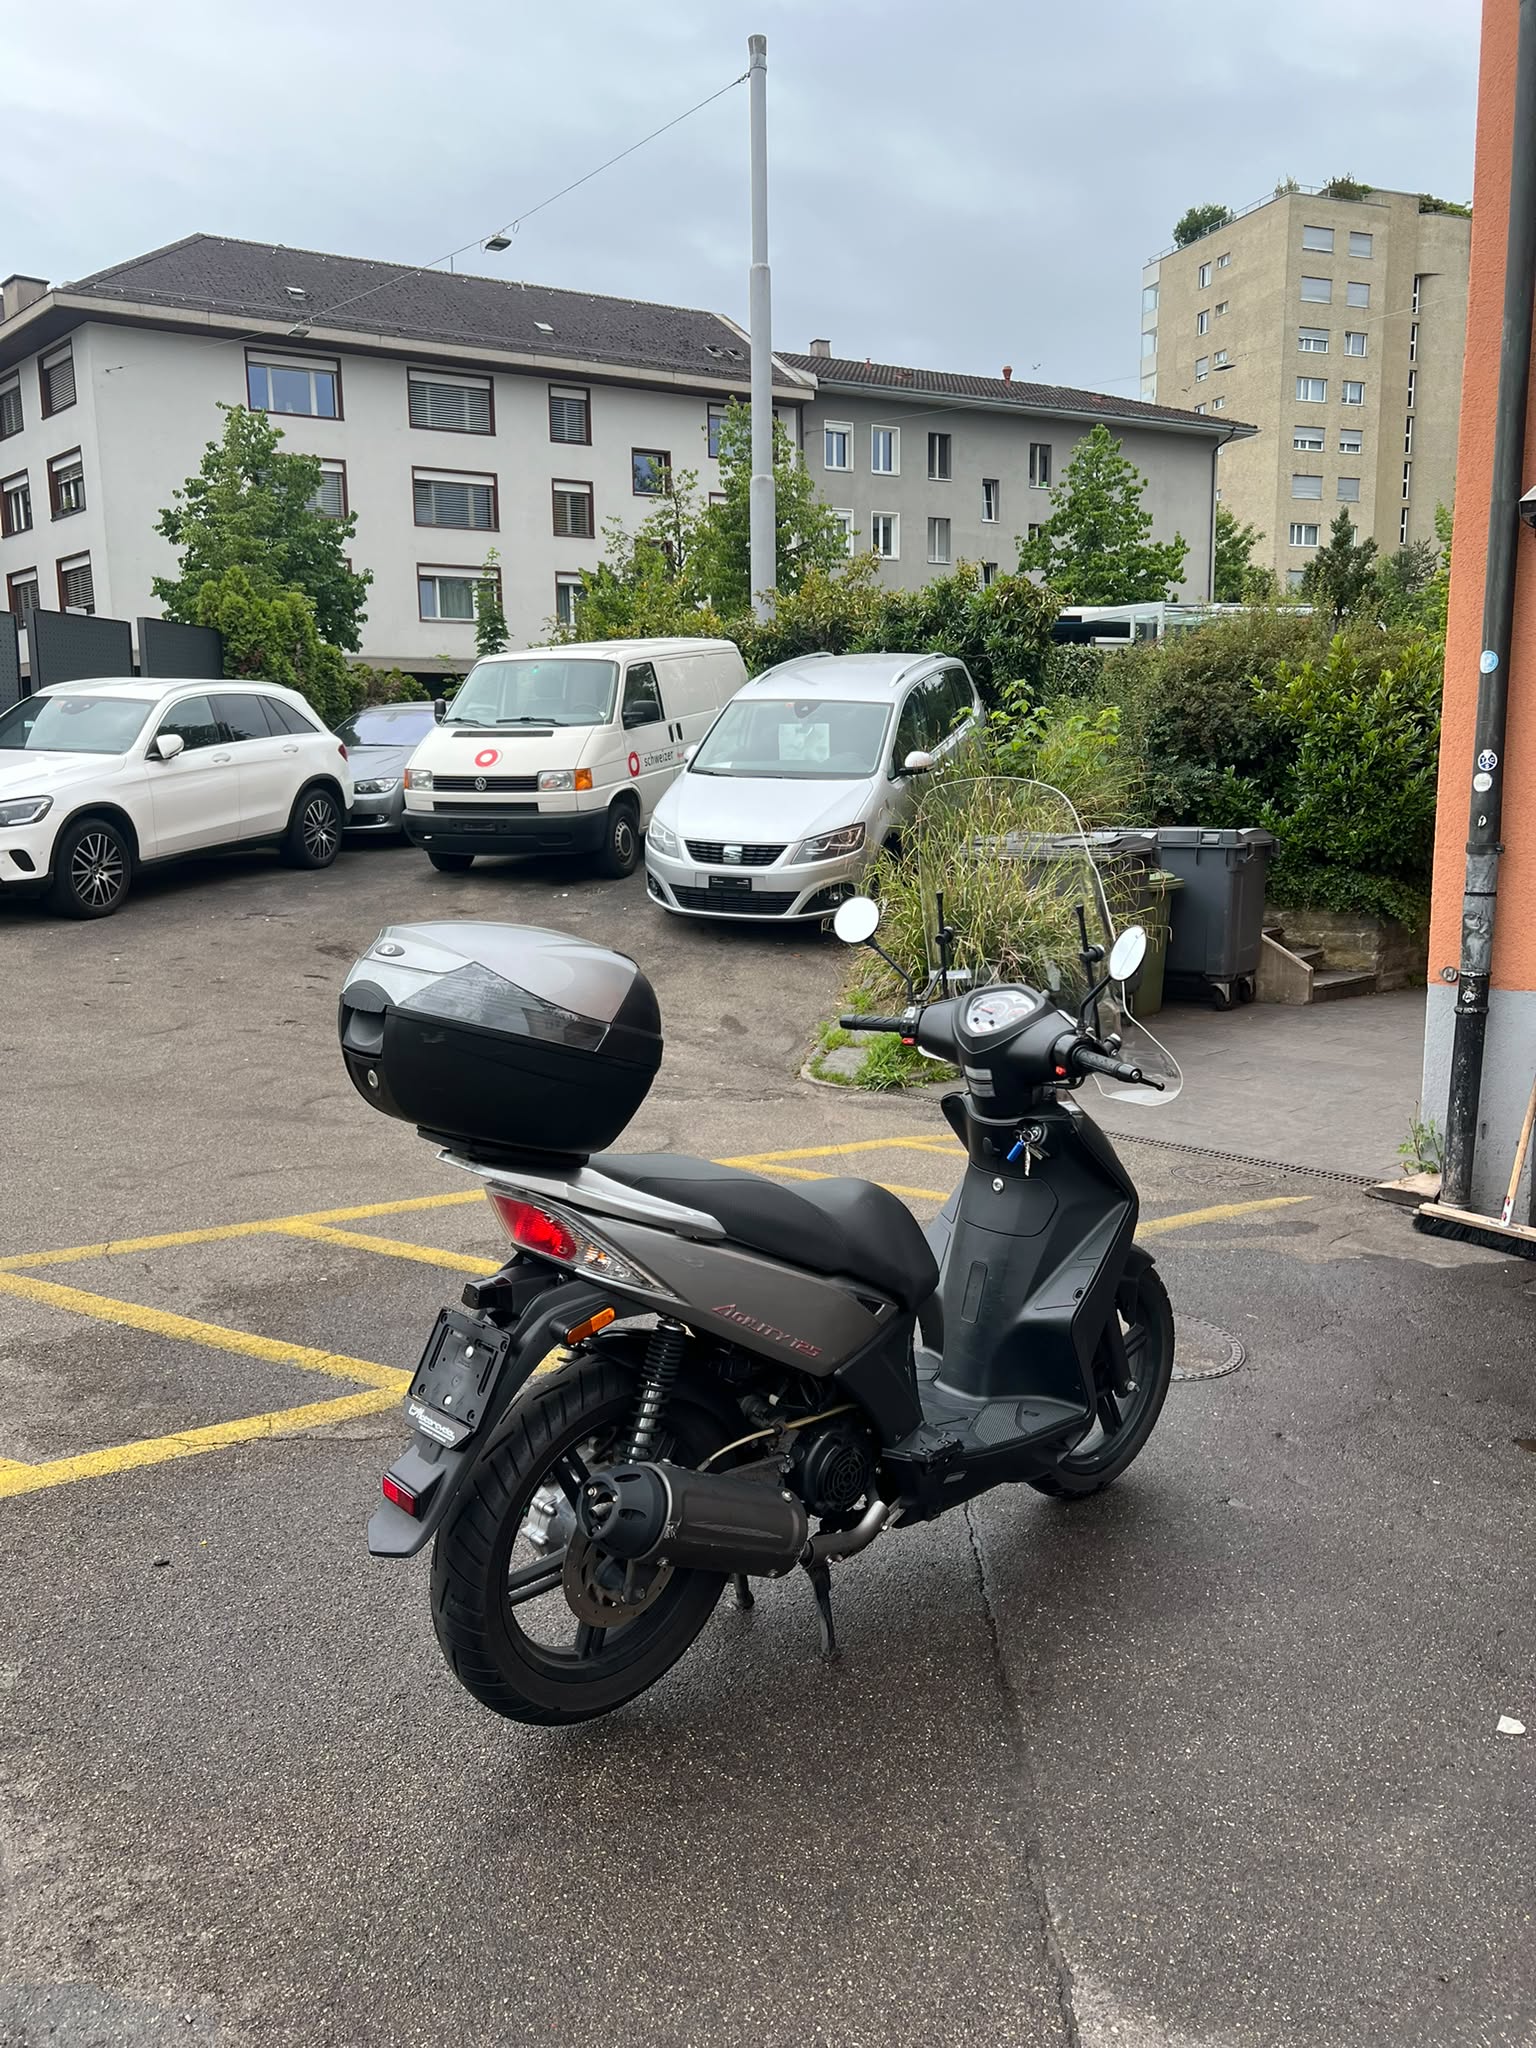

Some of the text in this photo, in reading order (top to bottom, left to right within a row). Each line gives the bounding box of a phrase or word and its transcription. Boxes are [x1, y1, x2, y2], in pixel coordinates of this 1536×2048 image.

[643, 751, 674, 767] schweizer
[711, 1303, 824, 1358] AGILITY 125
